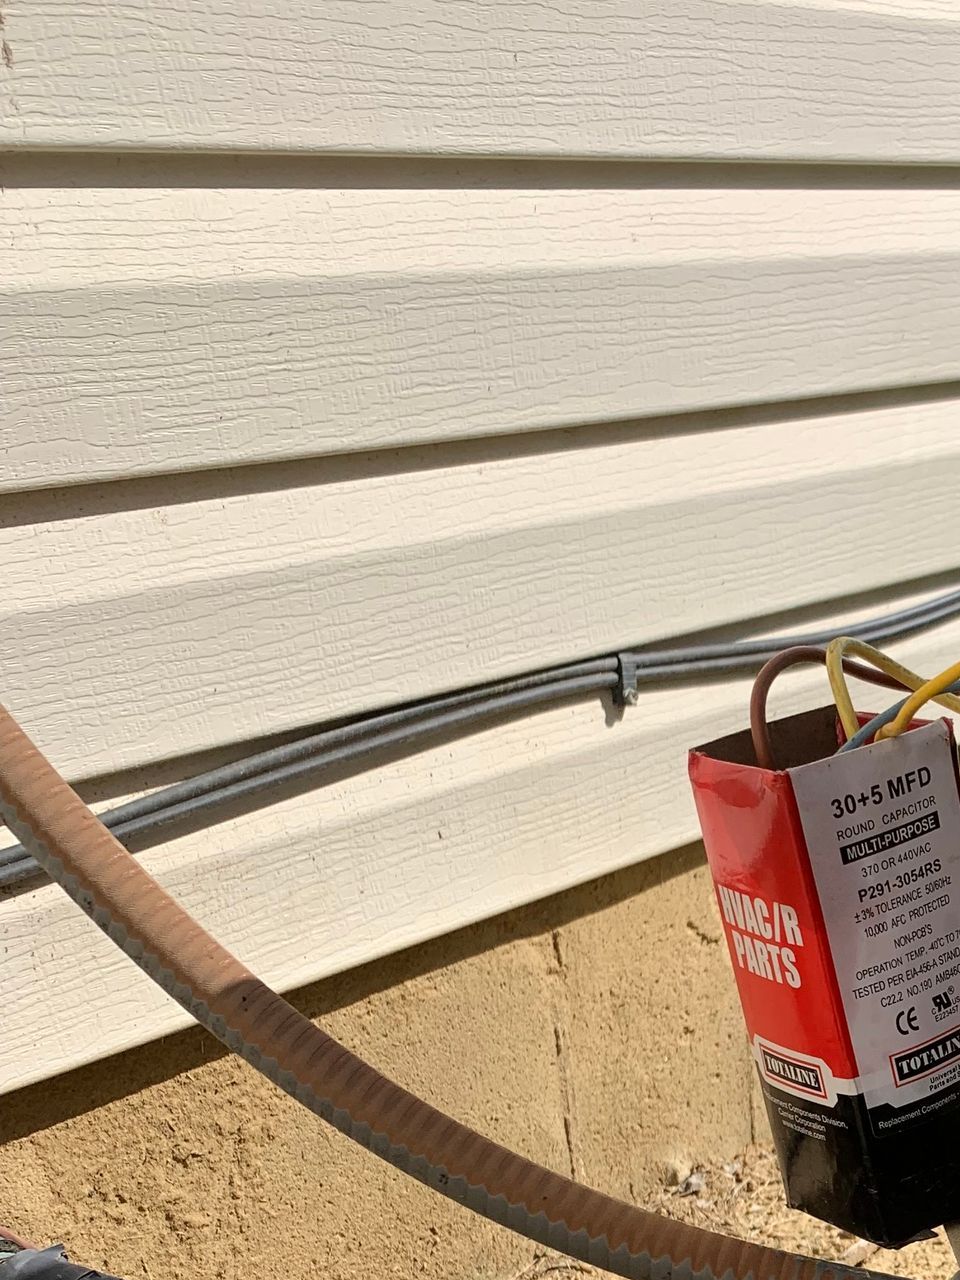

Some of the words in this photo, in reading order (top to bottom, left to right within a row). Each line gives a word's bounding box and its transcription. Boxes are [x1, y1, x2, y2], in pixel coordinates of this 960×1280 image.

[831, 784, 883, 819] 30+5
[887, 766, 931, 799] MFD
[836, 819, 875, 841] ROUND
[882, 795, 937, 825] CAPACITOR
[846, 815, 936, 861] MULTI-PURPOSE
[861, 863, 879, 877] 370
[881, 857, 896, 870] OR
[897, 842, 931, 863] 440VAC
[857, 858, 942, 903] P291-3054RS
[875, 887, 923, 916] TOLERANCE
[924, 875, 952, 895] 50/60Hz
[718, 883, 804, 947] HVAC/R
[864, 921, 889, 938] 10,000
[891, 914, 907, 929] AFC
[908, 894, 950, 921] PROTECTED
[855, 956, 903, 981] OPERATION
[905, 947, 928, 963] TEMP.
[944, 932, 955, 945] TO
[893, 923, 933, 949] NON-PCB'S
[731, 929, 801, 989] PARTS
[852, 980, 886, 1000] TESTED
[887, 973, 905, 988] PER
[906, 959, 939, 981] EIA-456-A
[880, 991, 904, 1008] C22.2
[906, 979, 933, 999] NO.190
[896, 1006, 920, 1035] CE
[764, 1054, 819, 1088] TOTALINE
[929, 1065, 958, 1084] Universal
[929, 1079, 945, 1092] Parts
[946, 1074, 957, 1085] and
[794, 1114, 826, 1132] Corporation
[878, 1108, 921, 1130] Replacement
[921, 1093, 957, 1115] Components
